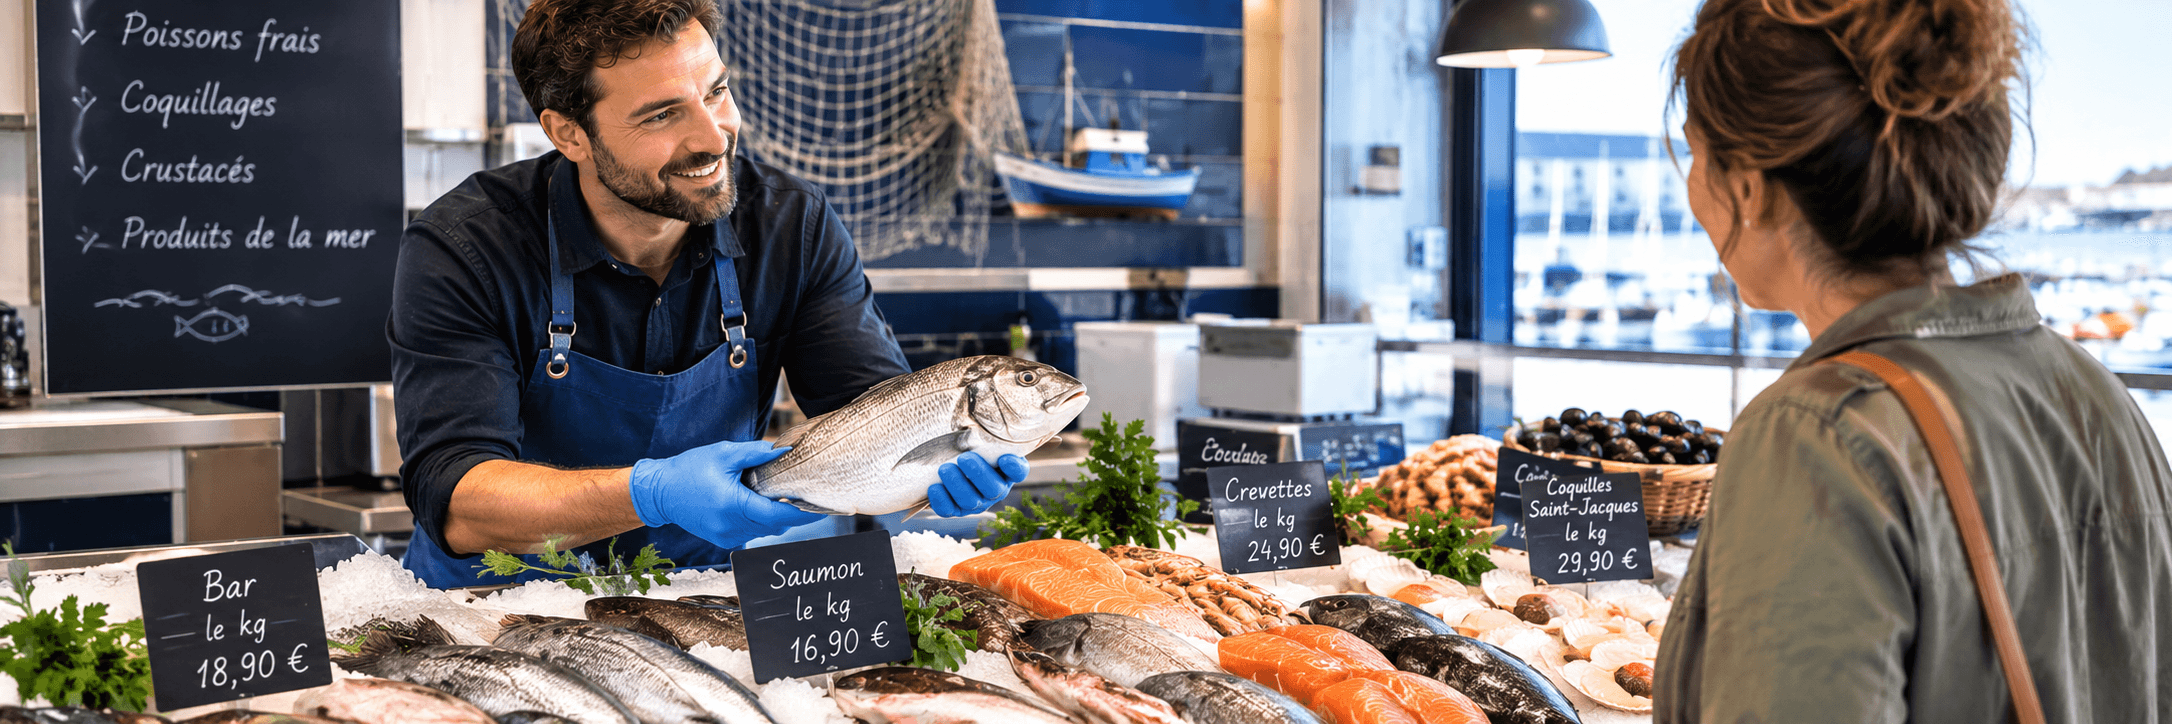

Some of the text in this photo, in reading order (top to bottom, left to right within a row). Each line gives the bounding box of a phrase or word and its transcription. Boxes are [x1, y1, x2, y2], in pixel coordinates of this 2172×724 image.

[121, 11, 321, 63] Poissons frais
[120, 80, 277, 130] Coquillages
[120, 148, 255, 183] Crustacés
[121, 215, 377, 249] Produits de la mer
[1225, 477, 1312, 502] Crevettes
[1547, 476, 1612, 501] Coquilles
[1254, 507, 1295, 532] le kg
[1529, 497, 1638, 522] Saint-Jacques
[1247, 533, 1326, 564] 24,90 €
[1565, 521, 1607, 546] le kg
[770, 558, 864, 589] Saumon
[1557, 547, 1638, 576] 29,90 €
[203, 569, 257, 602] Bar
[796, 592, 850, 623] le kg
[206, 609, 266, 643] le kg
[790, 620, 890, 665] 16,90 €
[197, 643, 309, 690] 18,90 €
